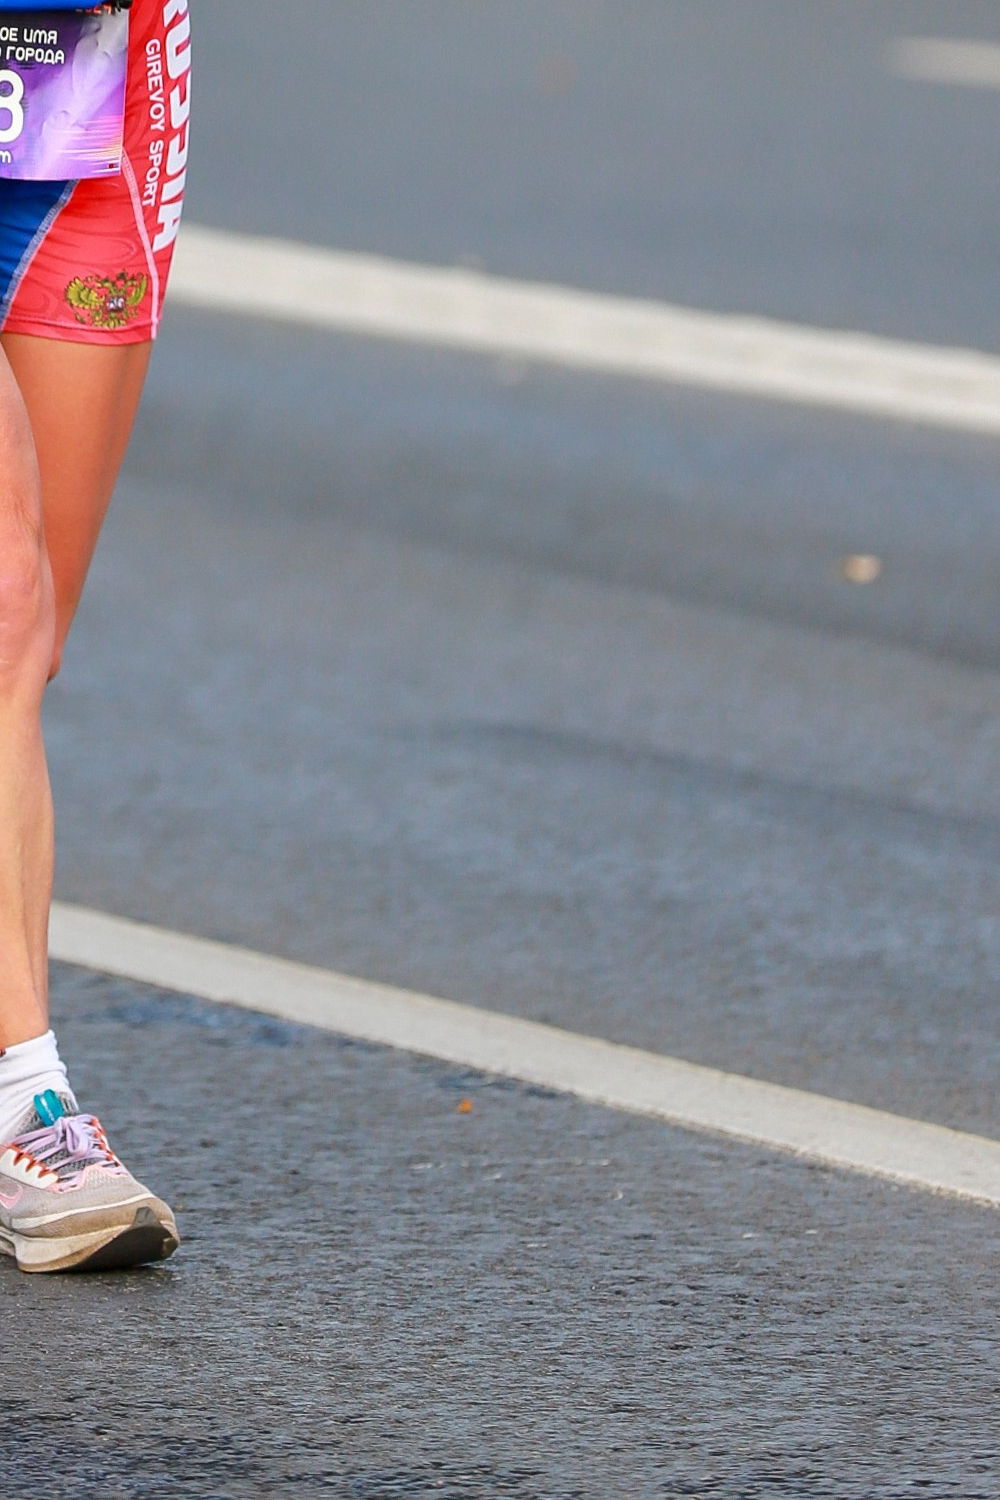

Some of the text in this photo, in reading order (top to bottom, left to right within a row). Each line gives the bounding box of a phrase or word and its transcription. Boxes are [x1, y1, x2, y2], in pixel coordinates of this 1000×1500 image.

[23, 28, 58, 45] ИМЯ
[6, 46, 65, 64] ГОРОДА
[142, 38, 166, 207] GIREVOY SPORT
